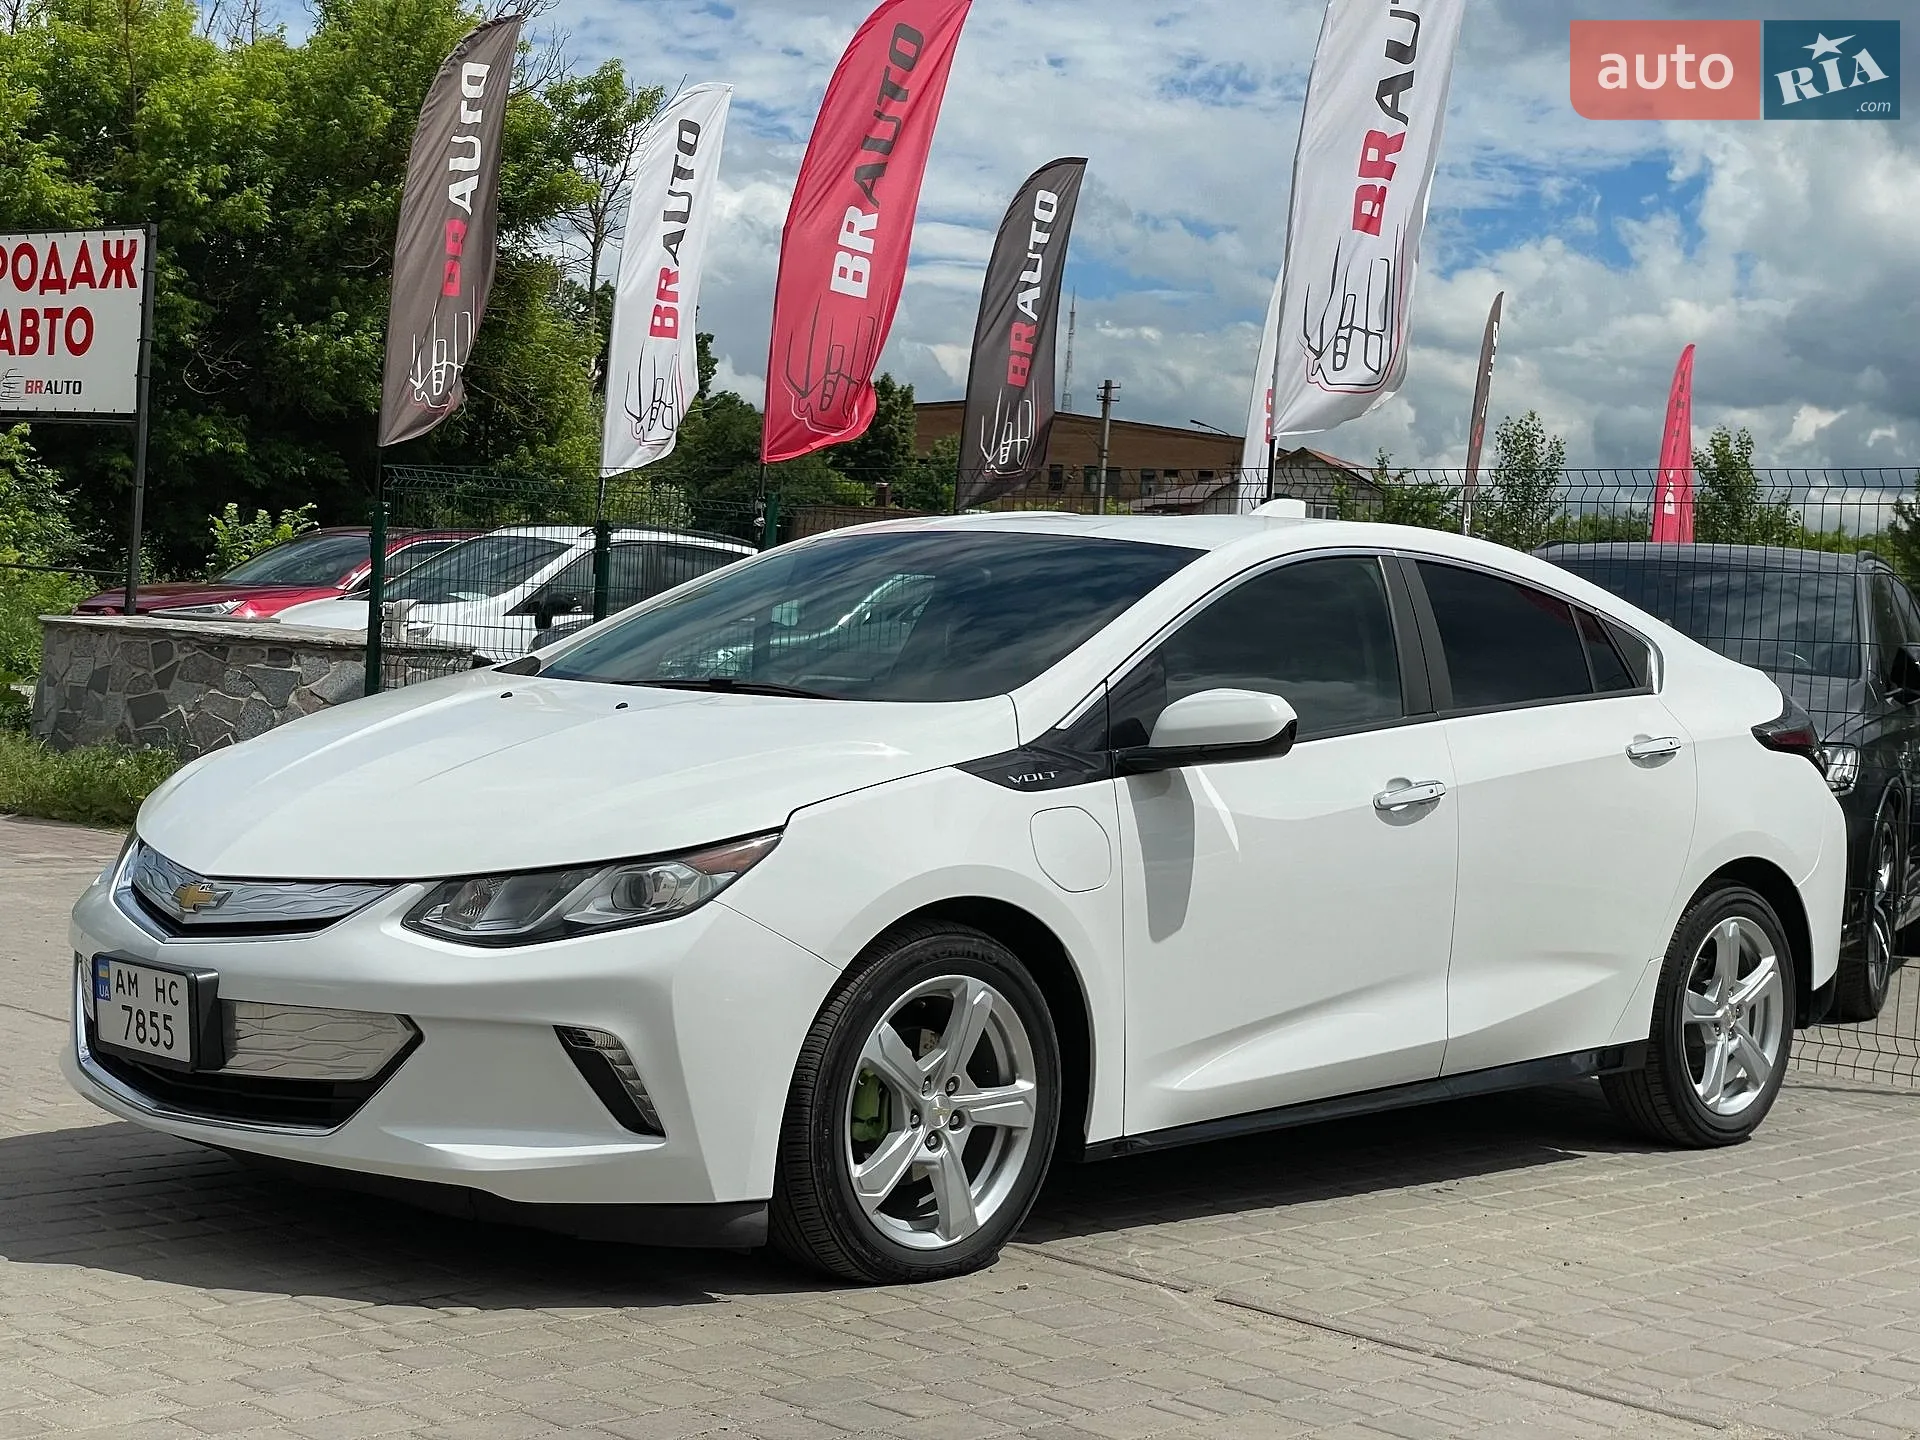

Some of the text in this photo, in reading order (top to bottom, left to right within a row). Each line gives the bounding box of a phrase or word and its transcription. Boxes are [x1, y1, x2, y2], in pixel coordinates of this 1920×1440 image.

[1352, 0, 1421, 237] BRAU
[830, 22, 925, 299] BRAUTO
[649, 119, 702, 339] BRAUTO
[1007, 189, 1058, 388] BRAUTO
[24, 379, 82, 395] BRAUTO
[1007, 770, 1059, 784] VOLT
[99, 985, 111, 998] UA
[115, 969, 179, 1006] AM HC
[121, 1004, 174, 1050] 7855
